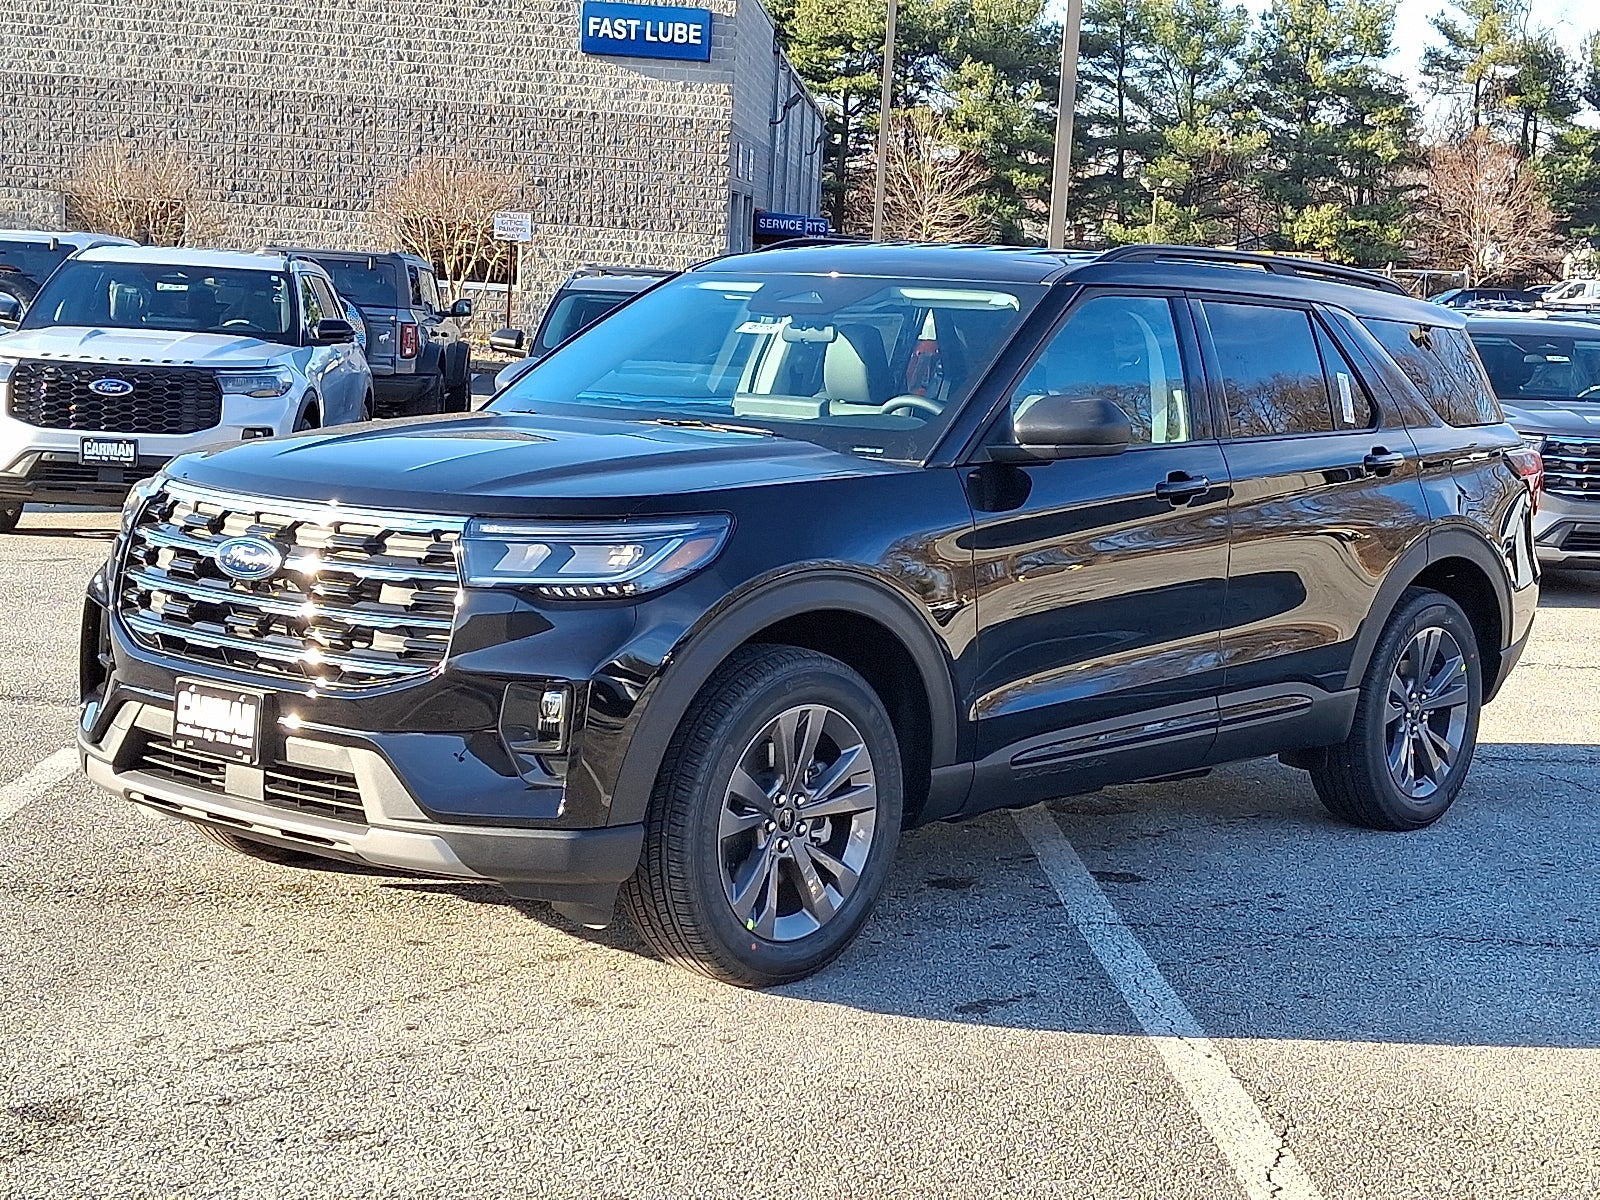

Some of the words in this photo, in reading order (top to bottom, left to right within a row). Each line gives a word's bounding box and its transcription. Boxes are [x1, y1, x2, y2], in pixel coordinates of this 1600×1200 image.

[588, 16, 641, 41] FAST
[645, 20, 703, 45] LUBE
[759, 218, 803, 231] SERVICE
[83, 441, 134, 456] CARMAN
[177, 690, 256, 737] CARMAN
